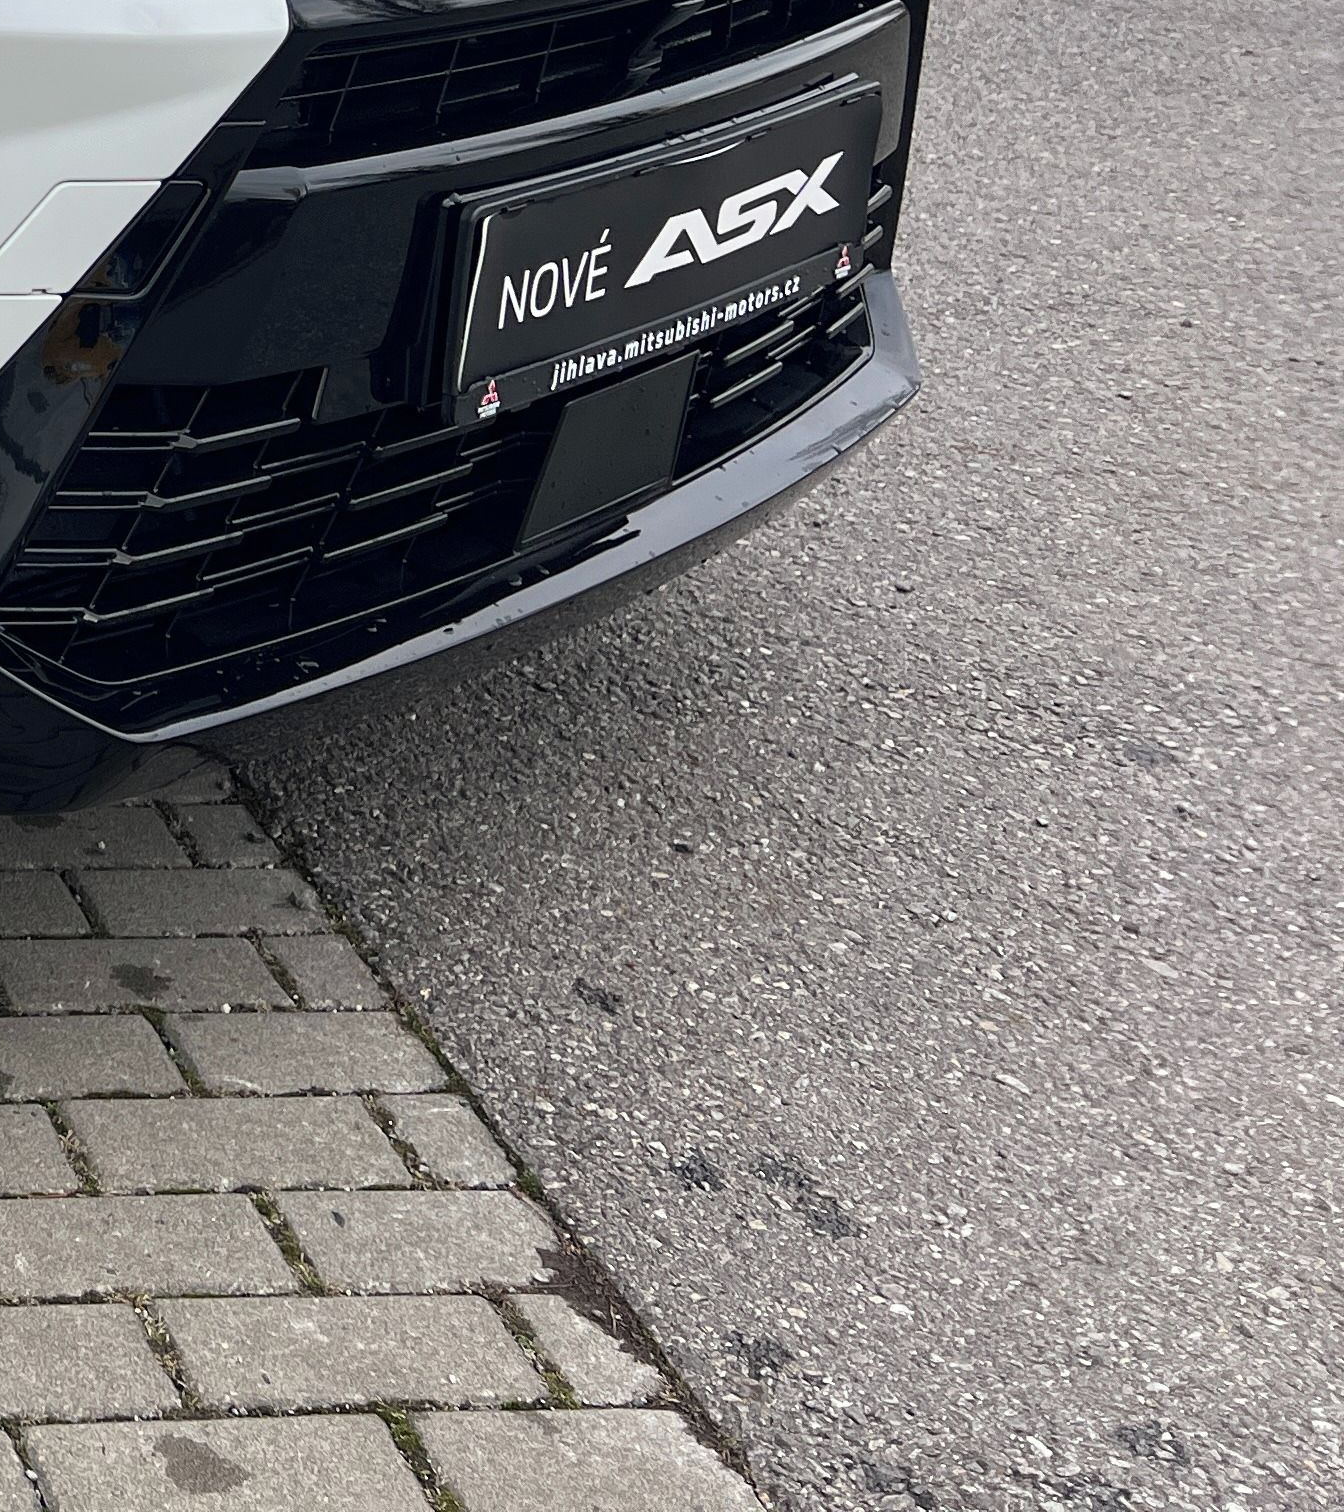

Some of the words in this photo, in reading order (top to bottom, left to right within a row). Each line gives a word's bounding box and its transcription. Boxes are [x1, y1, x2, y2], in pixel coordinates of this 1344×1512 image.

[497, 228, 612, 330] NOVÉ
[623, 150, 845, 289] ASX
[549, 275, 801, 392] jihlava.mitsubishi-motors.cz
